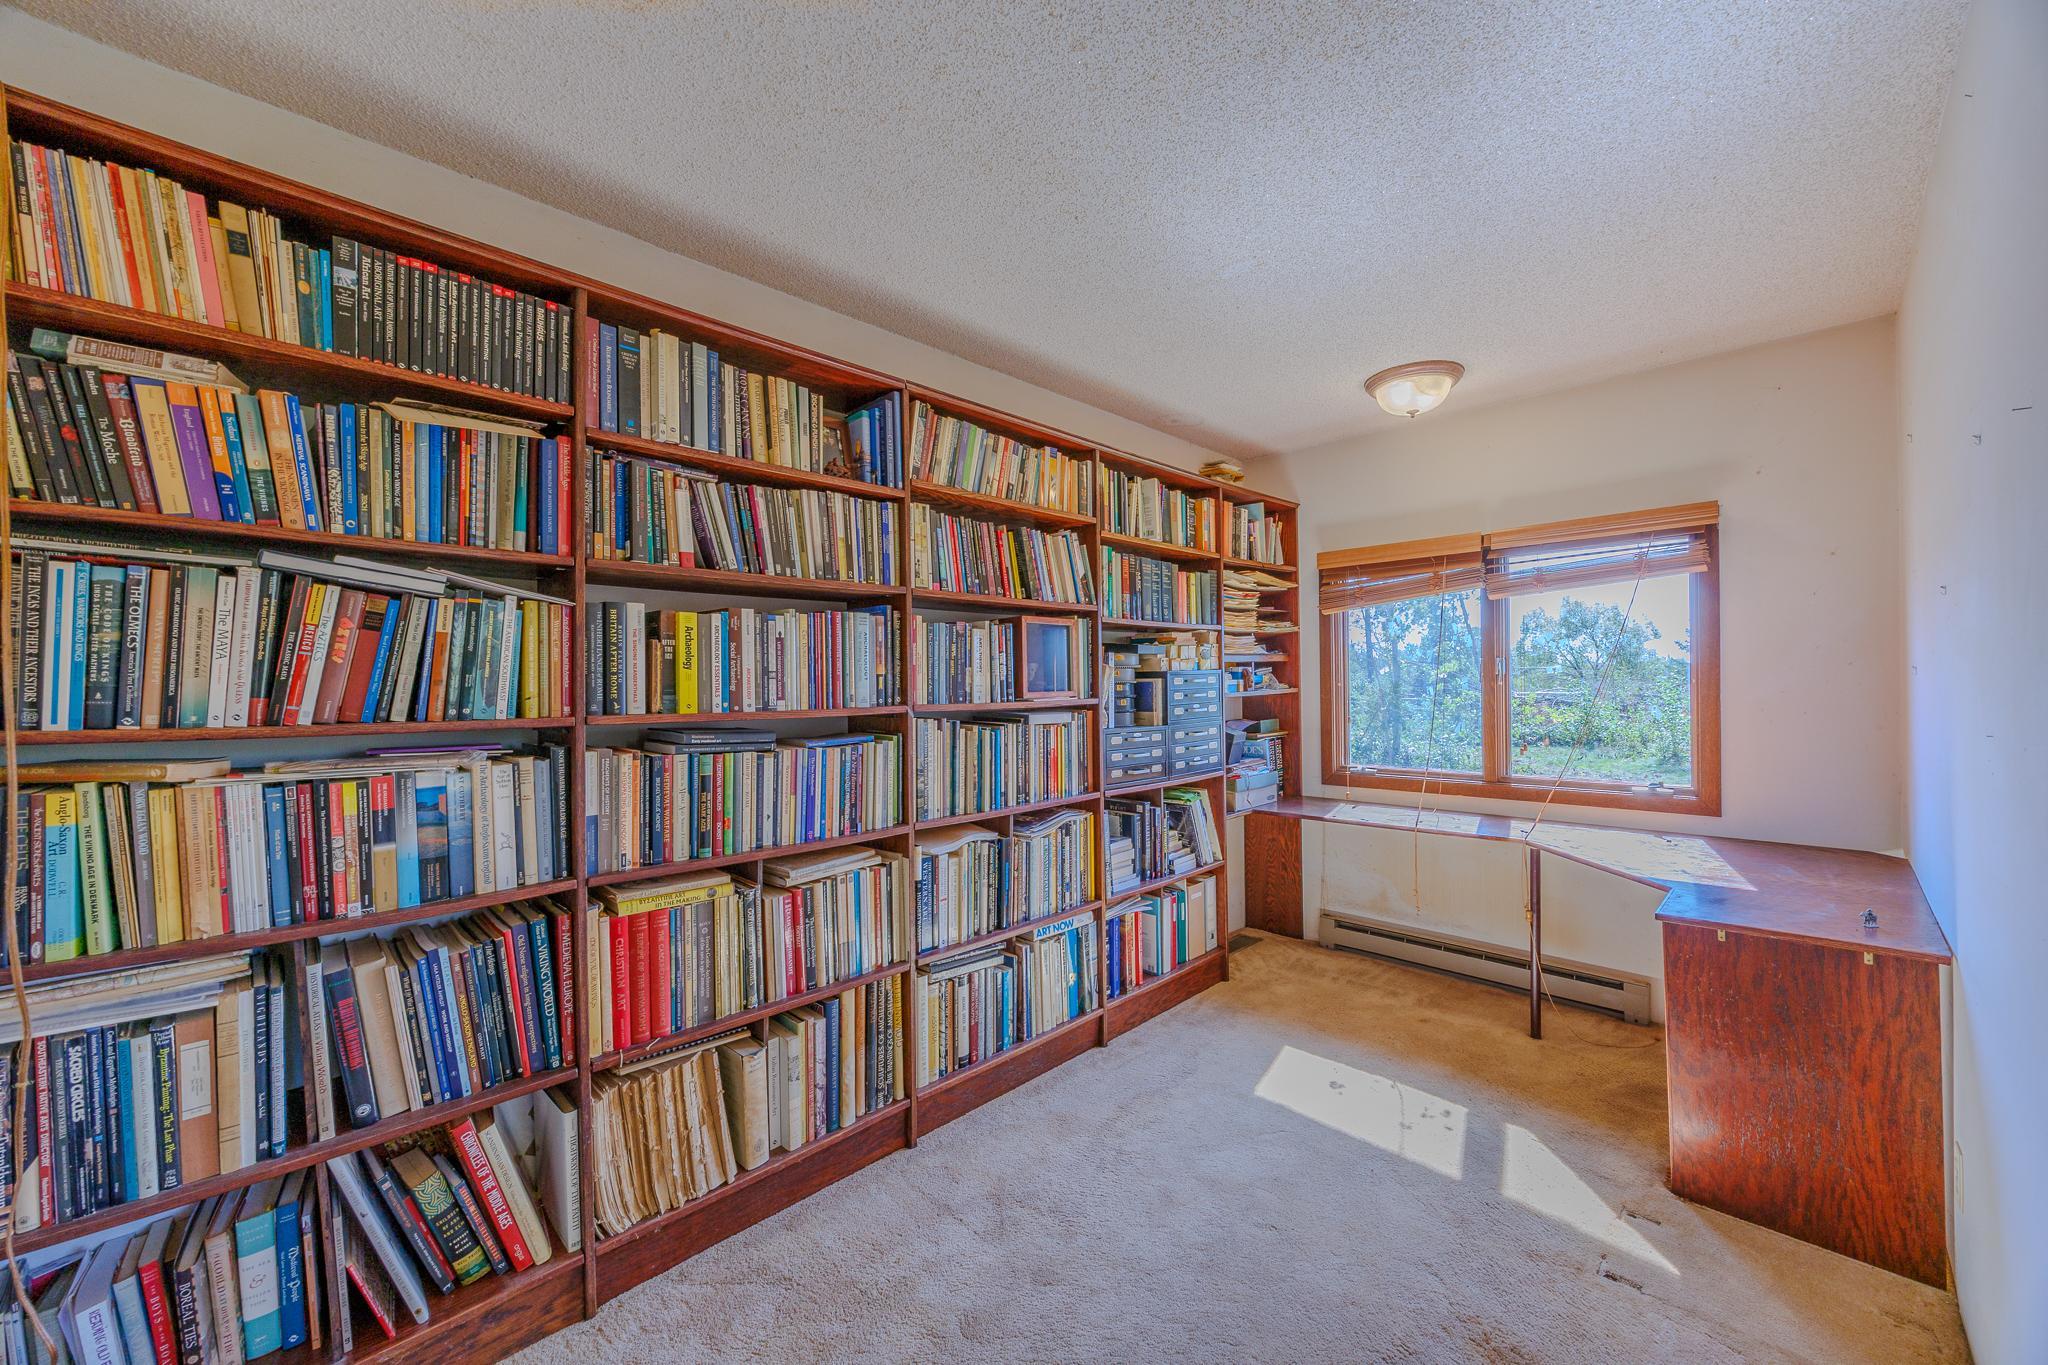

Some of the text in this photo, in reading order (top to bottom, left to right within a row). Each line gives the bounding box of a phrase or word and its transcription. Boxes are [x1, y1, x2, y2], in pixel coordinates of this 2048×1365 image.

[362, 256, 370, 299] African Art
[386, 263, 394, 281] NATIVE
[386, 282, 394, 295] ARTS
[374, 260, 382, 320] ABORIGINAL ART
[386, 319, 394, 342] AMERICA
[515, 302, 523, 359] Victorian Painting
[86, 371, 98, 395] Bawden
[21, 414, 29, 423] ART
[76, 405, 85, 418] TIKAL
[183, 409, 192, 428] England
[99, 418, 119, 464] The Moche
[212, 436, 224, 456] Britain
[226, 417, 238, 441] Scotland
[326, 415, 336, 443] RUNES
[295, 434, 311, 501] MEDIEVAL SCANDINAVIA
[561, 476, 570, 491] Ages
[256, 477, 269, 512] THE VIKINGS
[75, 572, 86, 661] SCRIBES, WARRIORS AND KINGS
[101, 585, 113, 682] THE CODE OF KINGS
[172, 603, 180, 637] ARCHAEOLOGY
[24, 567, 41, 702] THE INCAS AND THEIR ANCESTORS
[91, 633, 99, 651] PETER
[125, 585, 140, 711] THE OLMECS America's First Civilization
[216, 609, 231, 660] The MAYA
[302, 625, 315, 650] MEXICO
[314, 615, 332, 662] The AZTECS
[683, 626, 693, 670] Archaeology
[283, 643, 294, 664] CLASSIC
[500, 619, 513, 701] THE AMERICAN SOUTHWEST
[168, 663, 177, 695] MESOAMERICA
[280, 666, 288, 680] MAYA
[557, 750, 566, 800] NORTHUMBRIA'S
[81, 791, 90, 818] Randsborg
[55, 796, 71, 855] Anglo-Saxon
[84, 825, 92, 839] THE
[135, 789, 149, 855] NORWEGIAN WOOD
[47, 841, 59, 897] Art DODWELL
[85, 841, 94, 864] VIKING
[87, 865, 95, 879] AGE
[89, 890, 98, 924] DENMARK
[517, 935, 526, 945] Old
[1037, 919, 1073, 937] ART NOW
[486, 956, 495, 975] Vikings
[519, 947, 528, 964] Norse
[519, 966, 531, 986] religion
[537, 945, 553, 1016] VIKING WORLD
[562, 933, 573, 1015] MEDIEVAL EUROPE
[616, 938, 625, 1010] CHRISTIAN ART
[309, 972, 321, 1030] HISTORICAL ATLAS
[523, 994, 535, 1020] long-term
[256, 994, 266, 1064] NIGHTLANDS
[459, 995, 476, 1067] ANGLO-SAXON ENGLAND
[525, 1021, 537, 1053] perspectives
[69, 1046, 85, 1122] SACRED CIRCLES
[314, 1041, 327, 1094] Viking World
[37, 1041, 49, 1168] SOUTHEASTERN NATIVE ARTS DIRECTORY
[157, 1048, 175, 1163] Byzantine Painting: The Last Phase
[569, 1135, 578, 1177] HIGHWAYS
[461, 1131, 512, 1230] CHRONICLES OF THE MIDDLE AGES
[570, 1208, 579, 1230] FAITH
[150, 1295, 164, 1324] BOYS
[178, 1282, 198, 1349] BOREAL TIES
